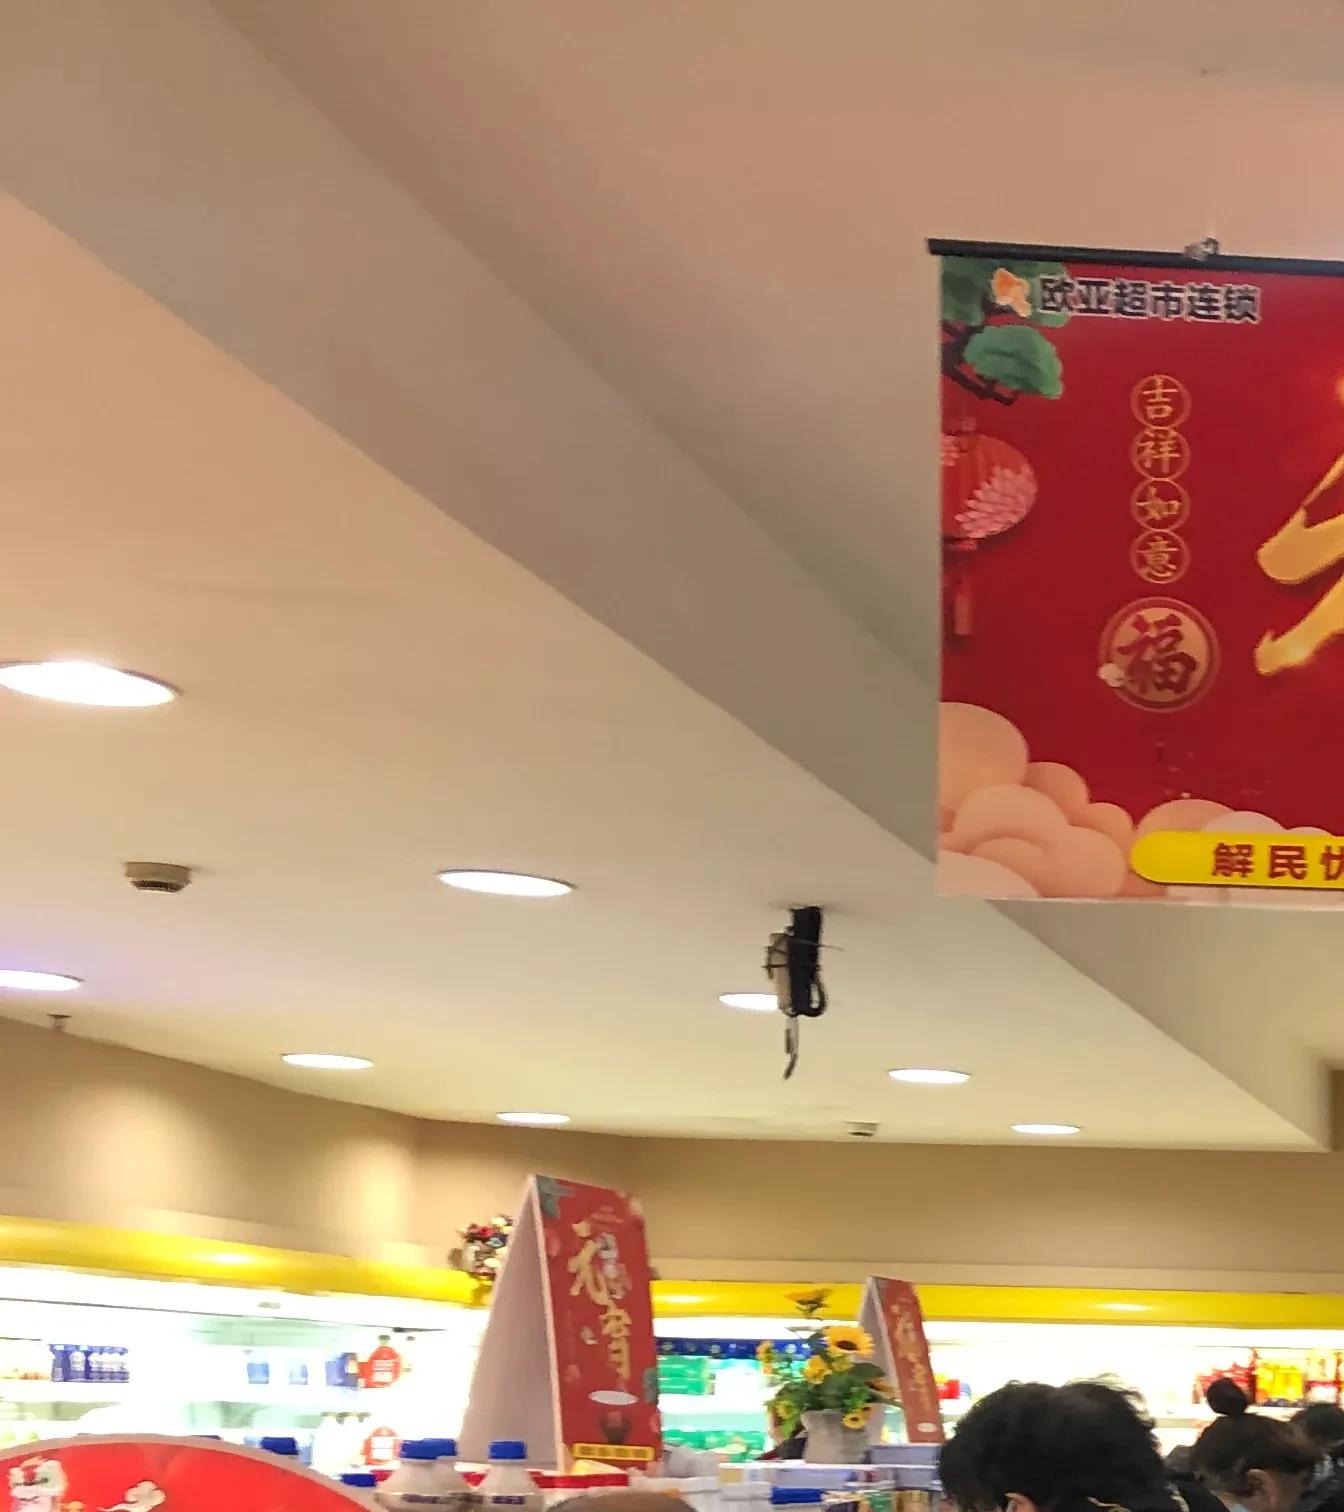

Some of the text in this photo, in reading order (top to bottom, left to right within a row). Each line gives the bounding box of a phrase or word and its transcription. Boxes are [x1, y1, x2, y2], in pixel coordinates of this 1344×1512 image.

[1038, 275, 1262, 324] 欧亚超市连锁
[1136, 376, 1186, 579] 吉祥如意
[1115, 610, 1199, 697] 福
